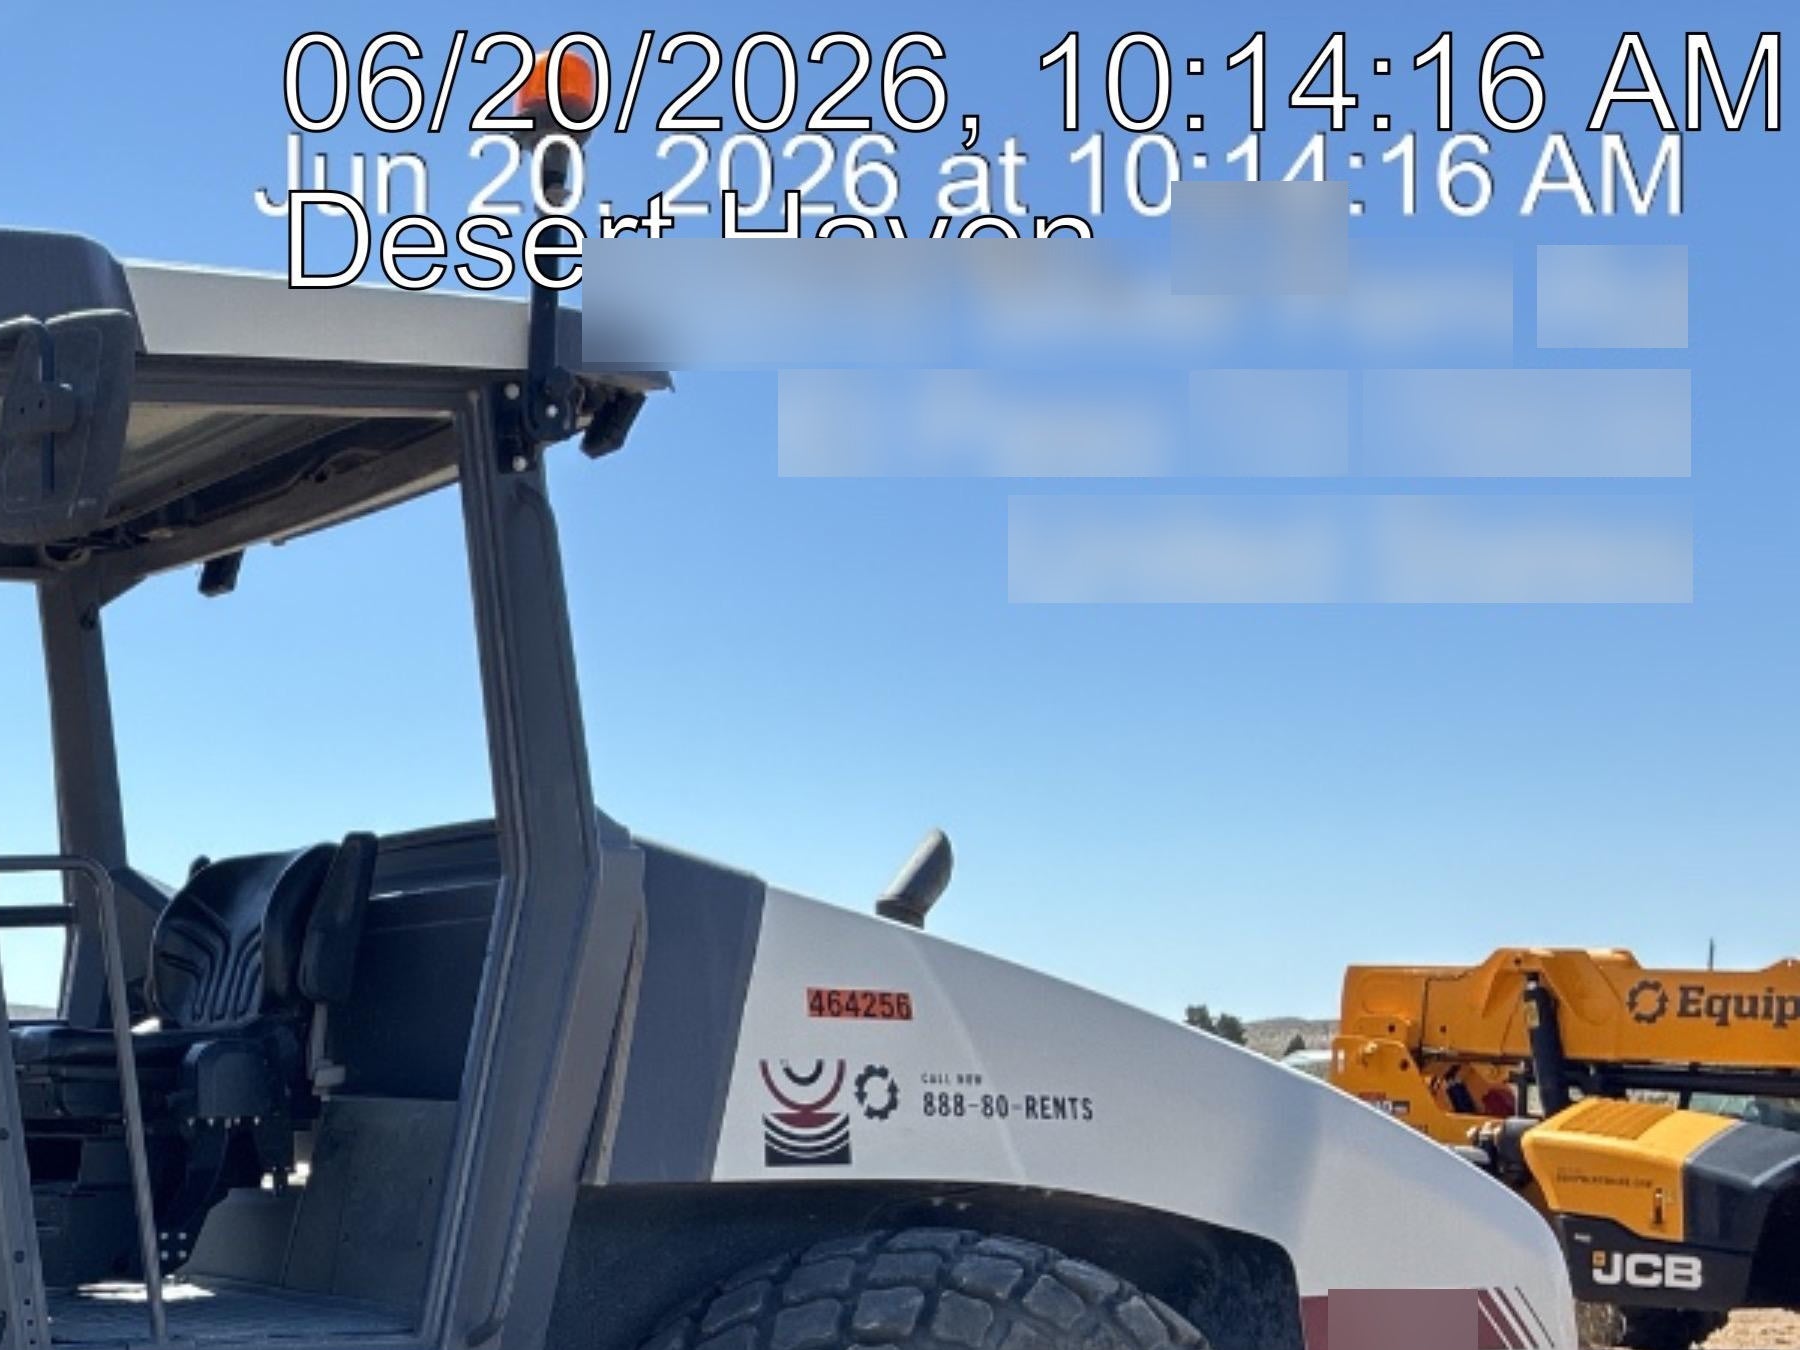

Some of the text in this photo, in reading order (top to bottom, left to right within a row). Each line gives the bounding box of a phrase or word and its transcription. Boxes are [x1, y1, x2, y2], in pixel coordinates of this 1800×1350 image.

[808, 989, 913, 1019] 464256
[1677, 985, 1800, 1029] Equip
[922, 1091, 1094, 1121] 888-80-RENTS
[1592, 1251, 1703, 1290] JCB
